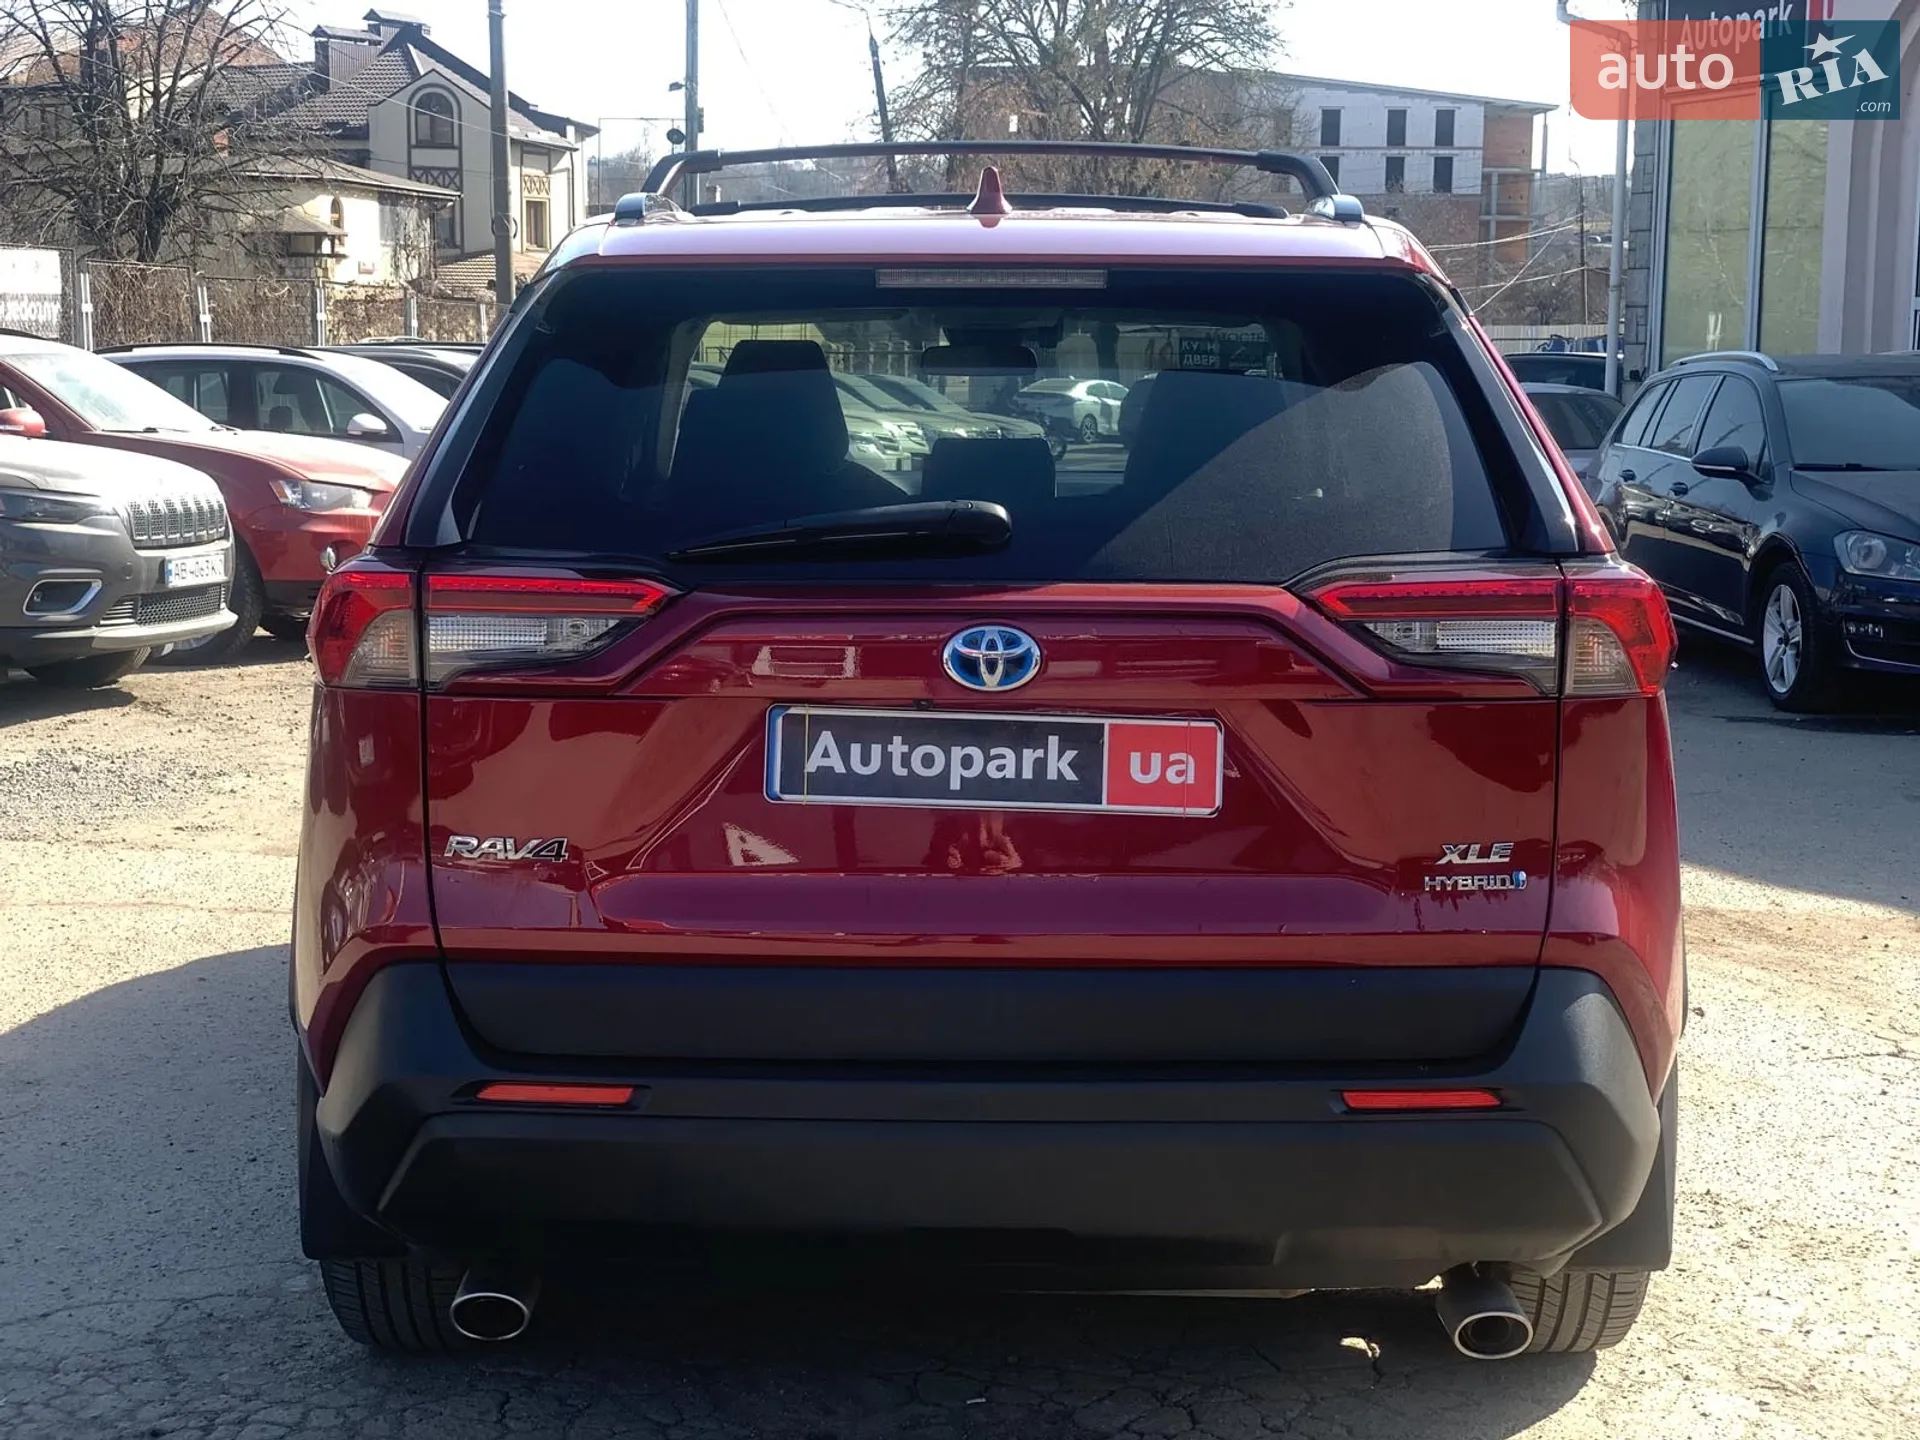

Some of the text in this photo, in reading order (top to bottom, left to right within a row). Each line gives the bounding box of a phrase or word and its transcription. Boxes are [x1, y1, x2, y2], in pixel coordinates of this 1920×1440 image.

[805, 729, 1196, 791] Autopark ua
[444, 836, 569, 863] RAV4
[1435, 843, 1514, 865] XLE
[1424, 875, 1512, 891] HYBRID
